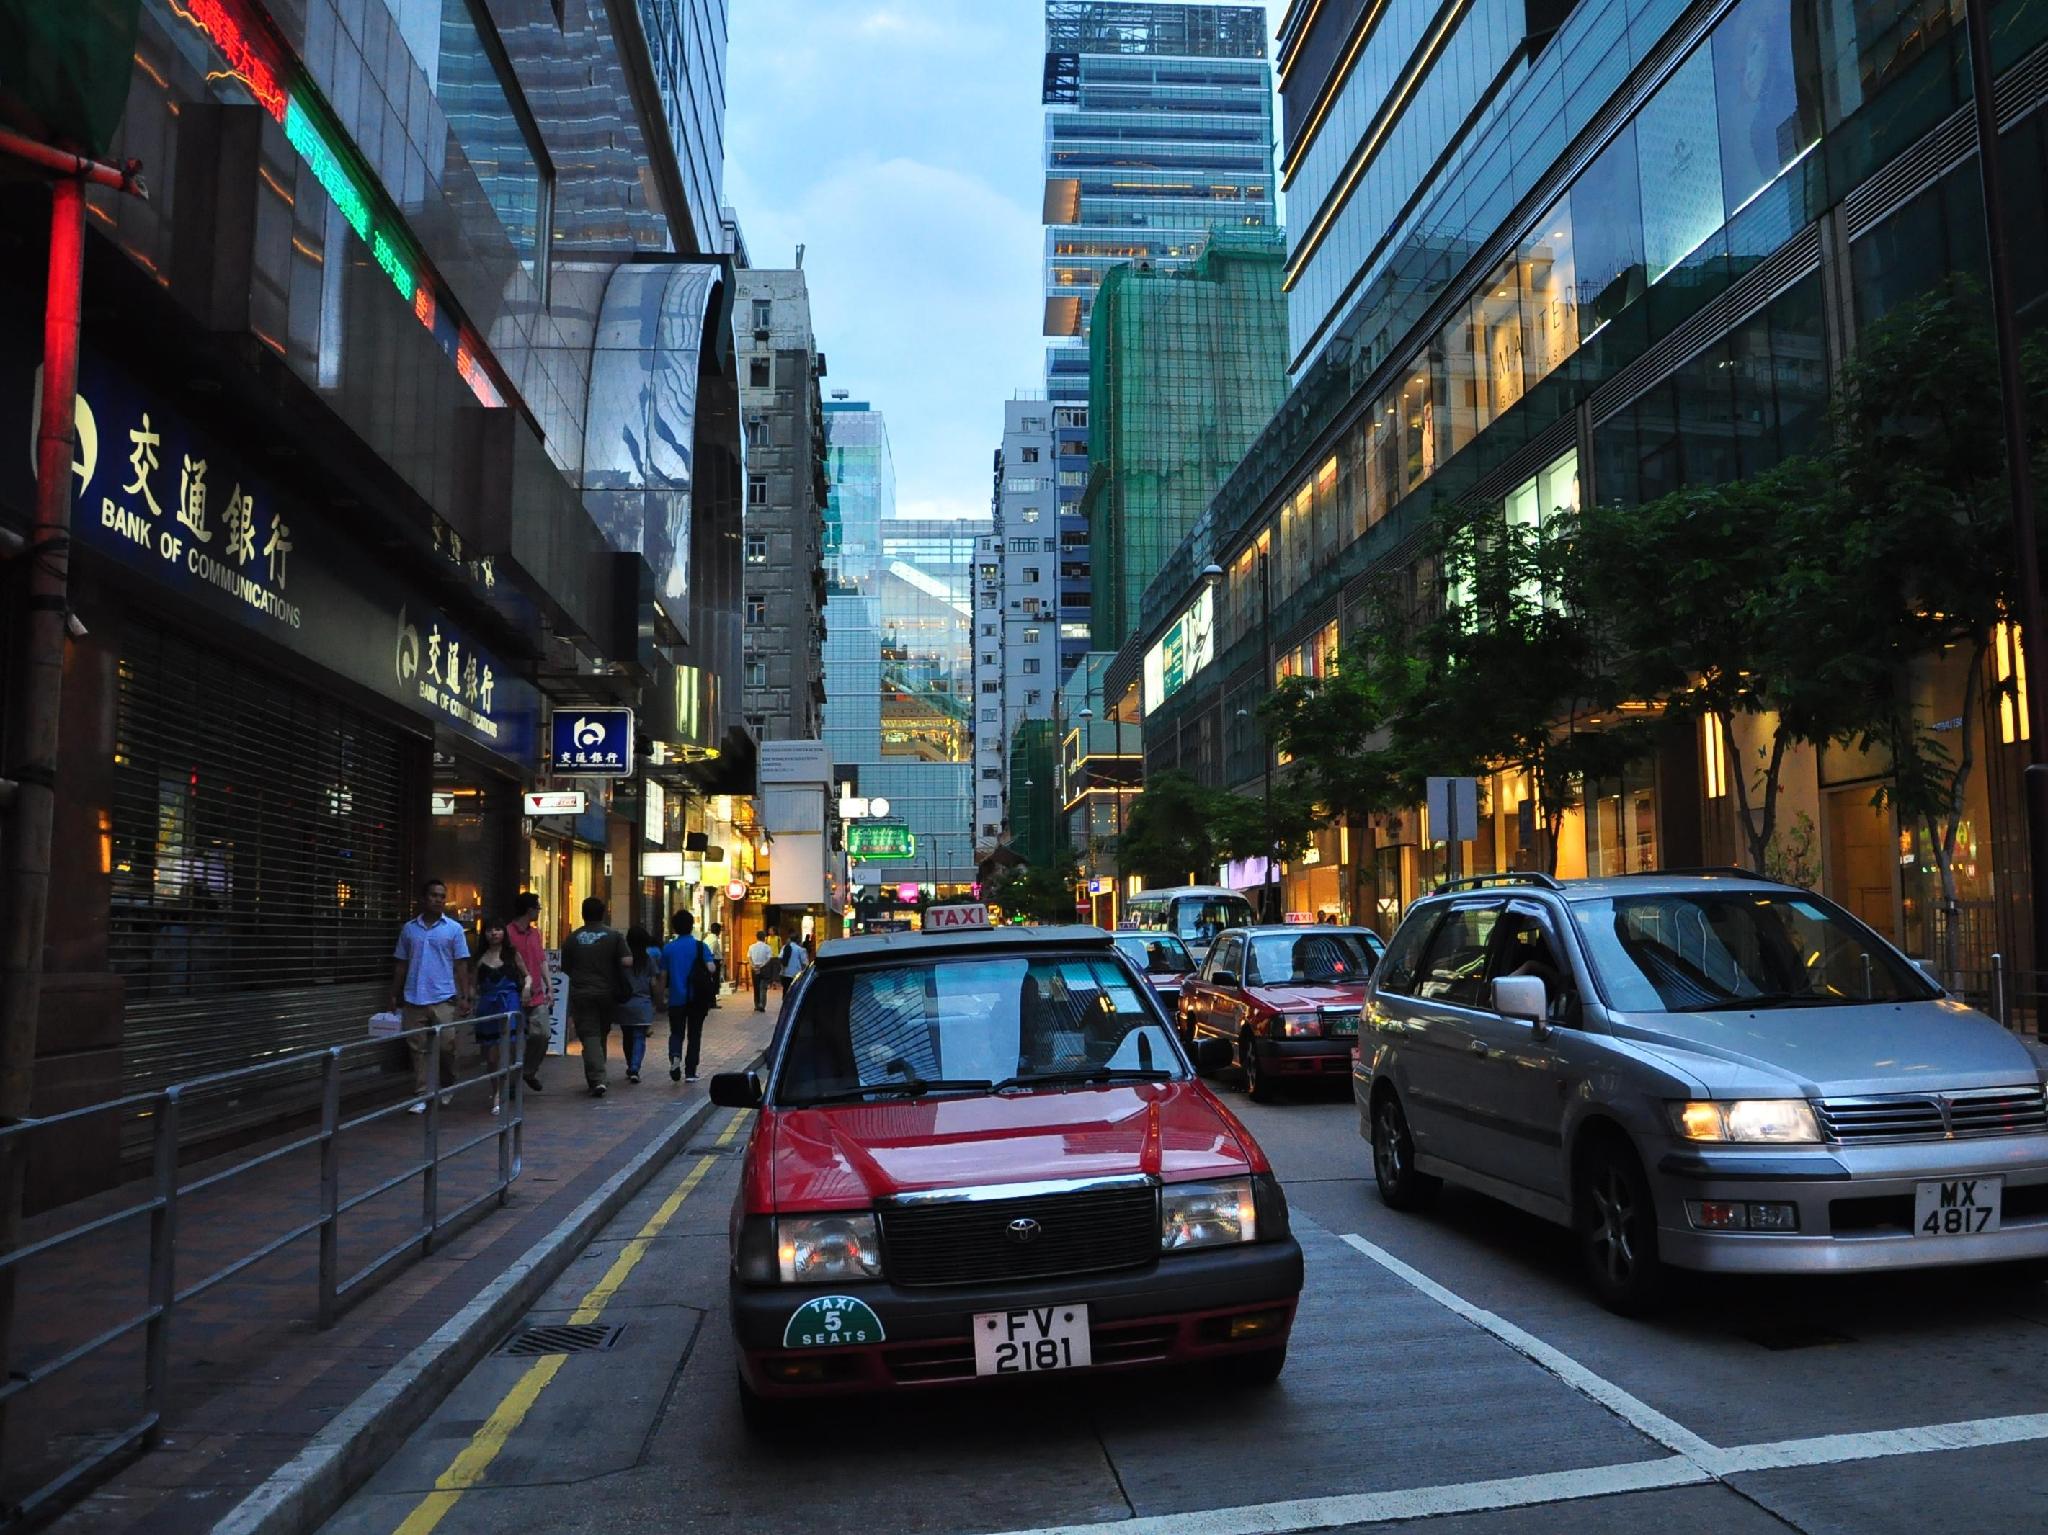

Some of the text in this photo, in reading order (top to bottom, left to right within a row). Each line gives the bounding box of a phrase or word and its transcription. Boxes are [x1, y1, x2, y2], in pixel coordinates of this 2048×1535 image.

[122, 412, 293, 590] 交通銀行
[101, 497, 301, 628] BANK OF COMMUNICATIONS
[426, 624, 495, 715] 交通銀行
[419, 680, 438, 705] BANK
[931, 908, 984, 926] TAXI
[1287, 914, 1313, 922] TAXI
[1940, 1181, 1978, 1208] MX
[1922, 1206, 1994, 1235] 4817
[810, 1297, 856, 1313] TAXI
[824, 1311, 842, 1331] 5
[1006, 1308, 1055, 1341] FV
[802, 1330, 867, 1345] SEATS
[995, 1337, 1072, 1373] 2181
